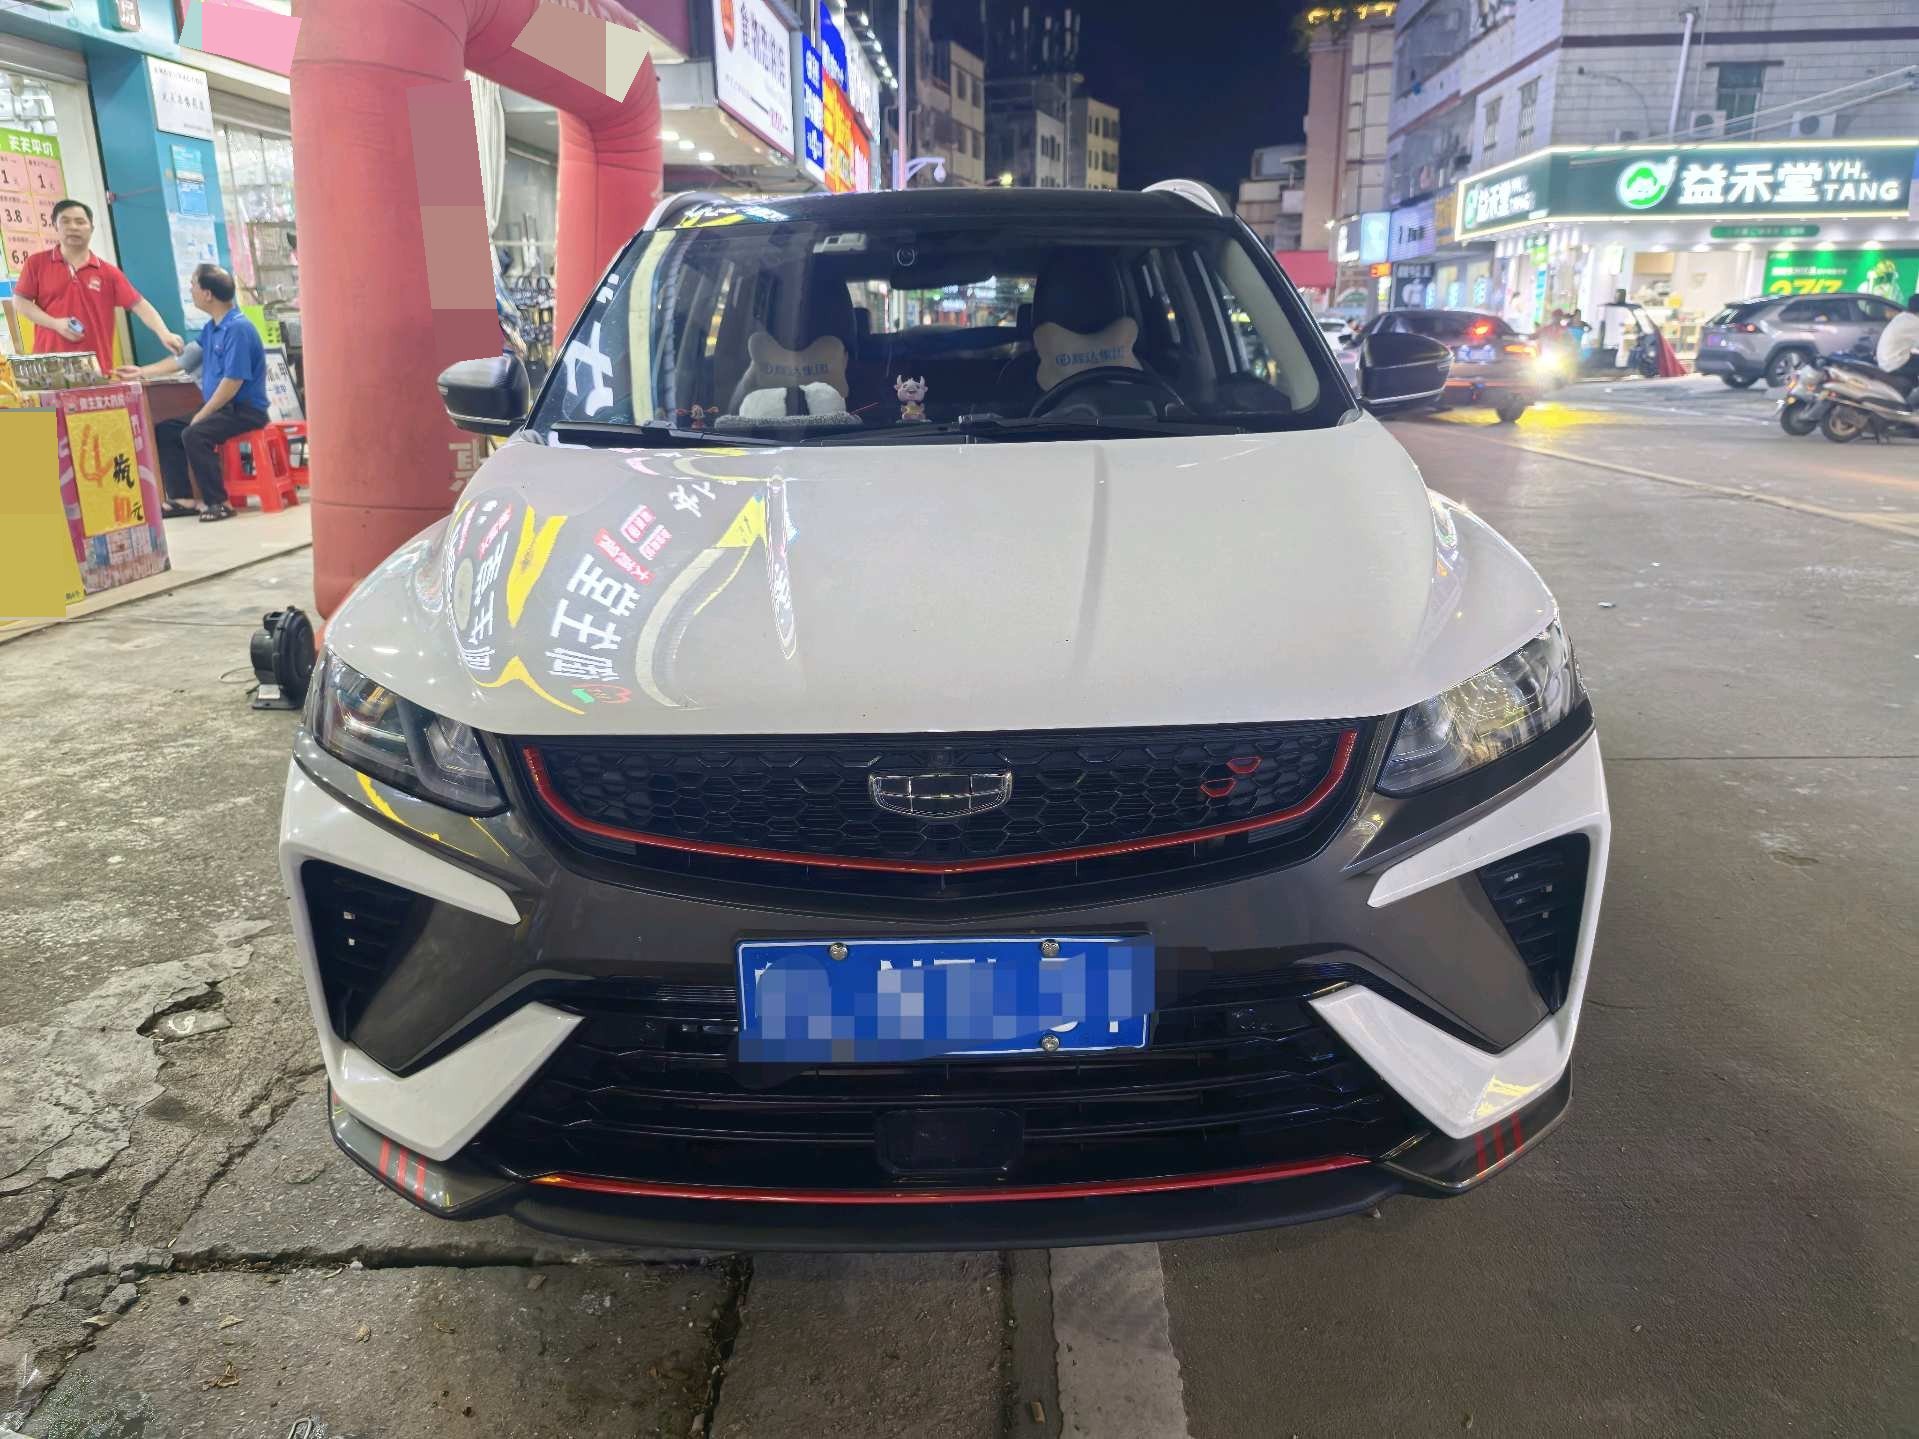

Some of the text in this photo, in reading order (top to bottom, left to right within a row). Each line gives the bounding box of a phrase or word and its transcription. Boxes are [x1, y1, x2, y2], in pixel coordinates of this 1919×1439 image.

[1677, 160, 1823, 205] 益禾堂
[1824, 182, 1899, 202] TANG
